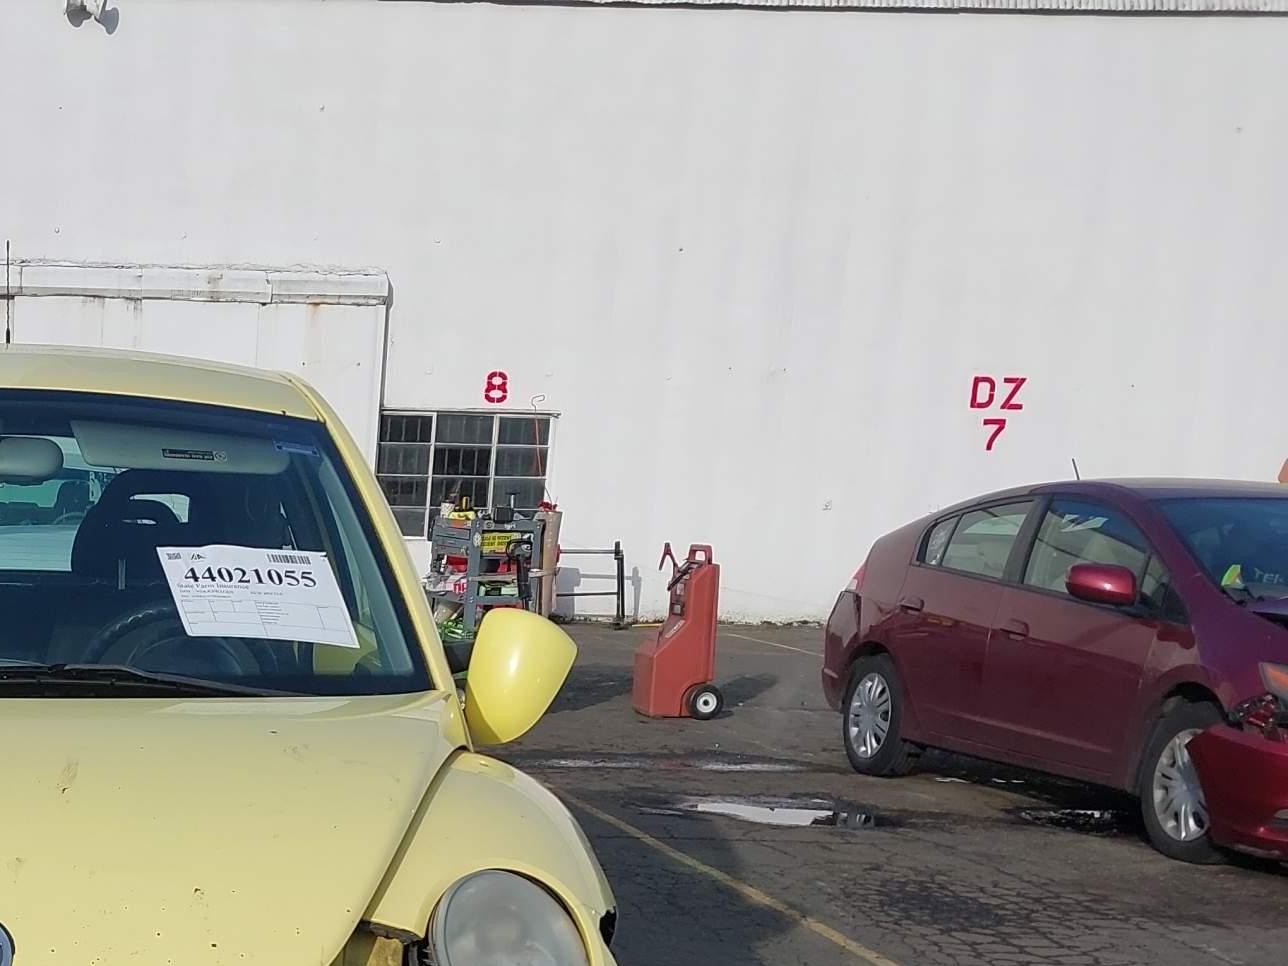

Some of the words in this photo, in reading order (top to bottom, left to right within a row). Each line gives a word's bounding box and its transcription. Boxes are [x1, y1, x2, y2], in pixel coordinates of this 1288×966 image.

[484, 371, 508, 404] 8
[970, 376, 1028, 411] DZ
[983, 418, 1007, 451] 7
[184, 566, 317, 588] 44021055
